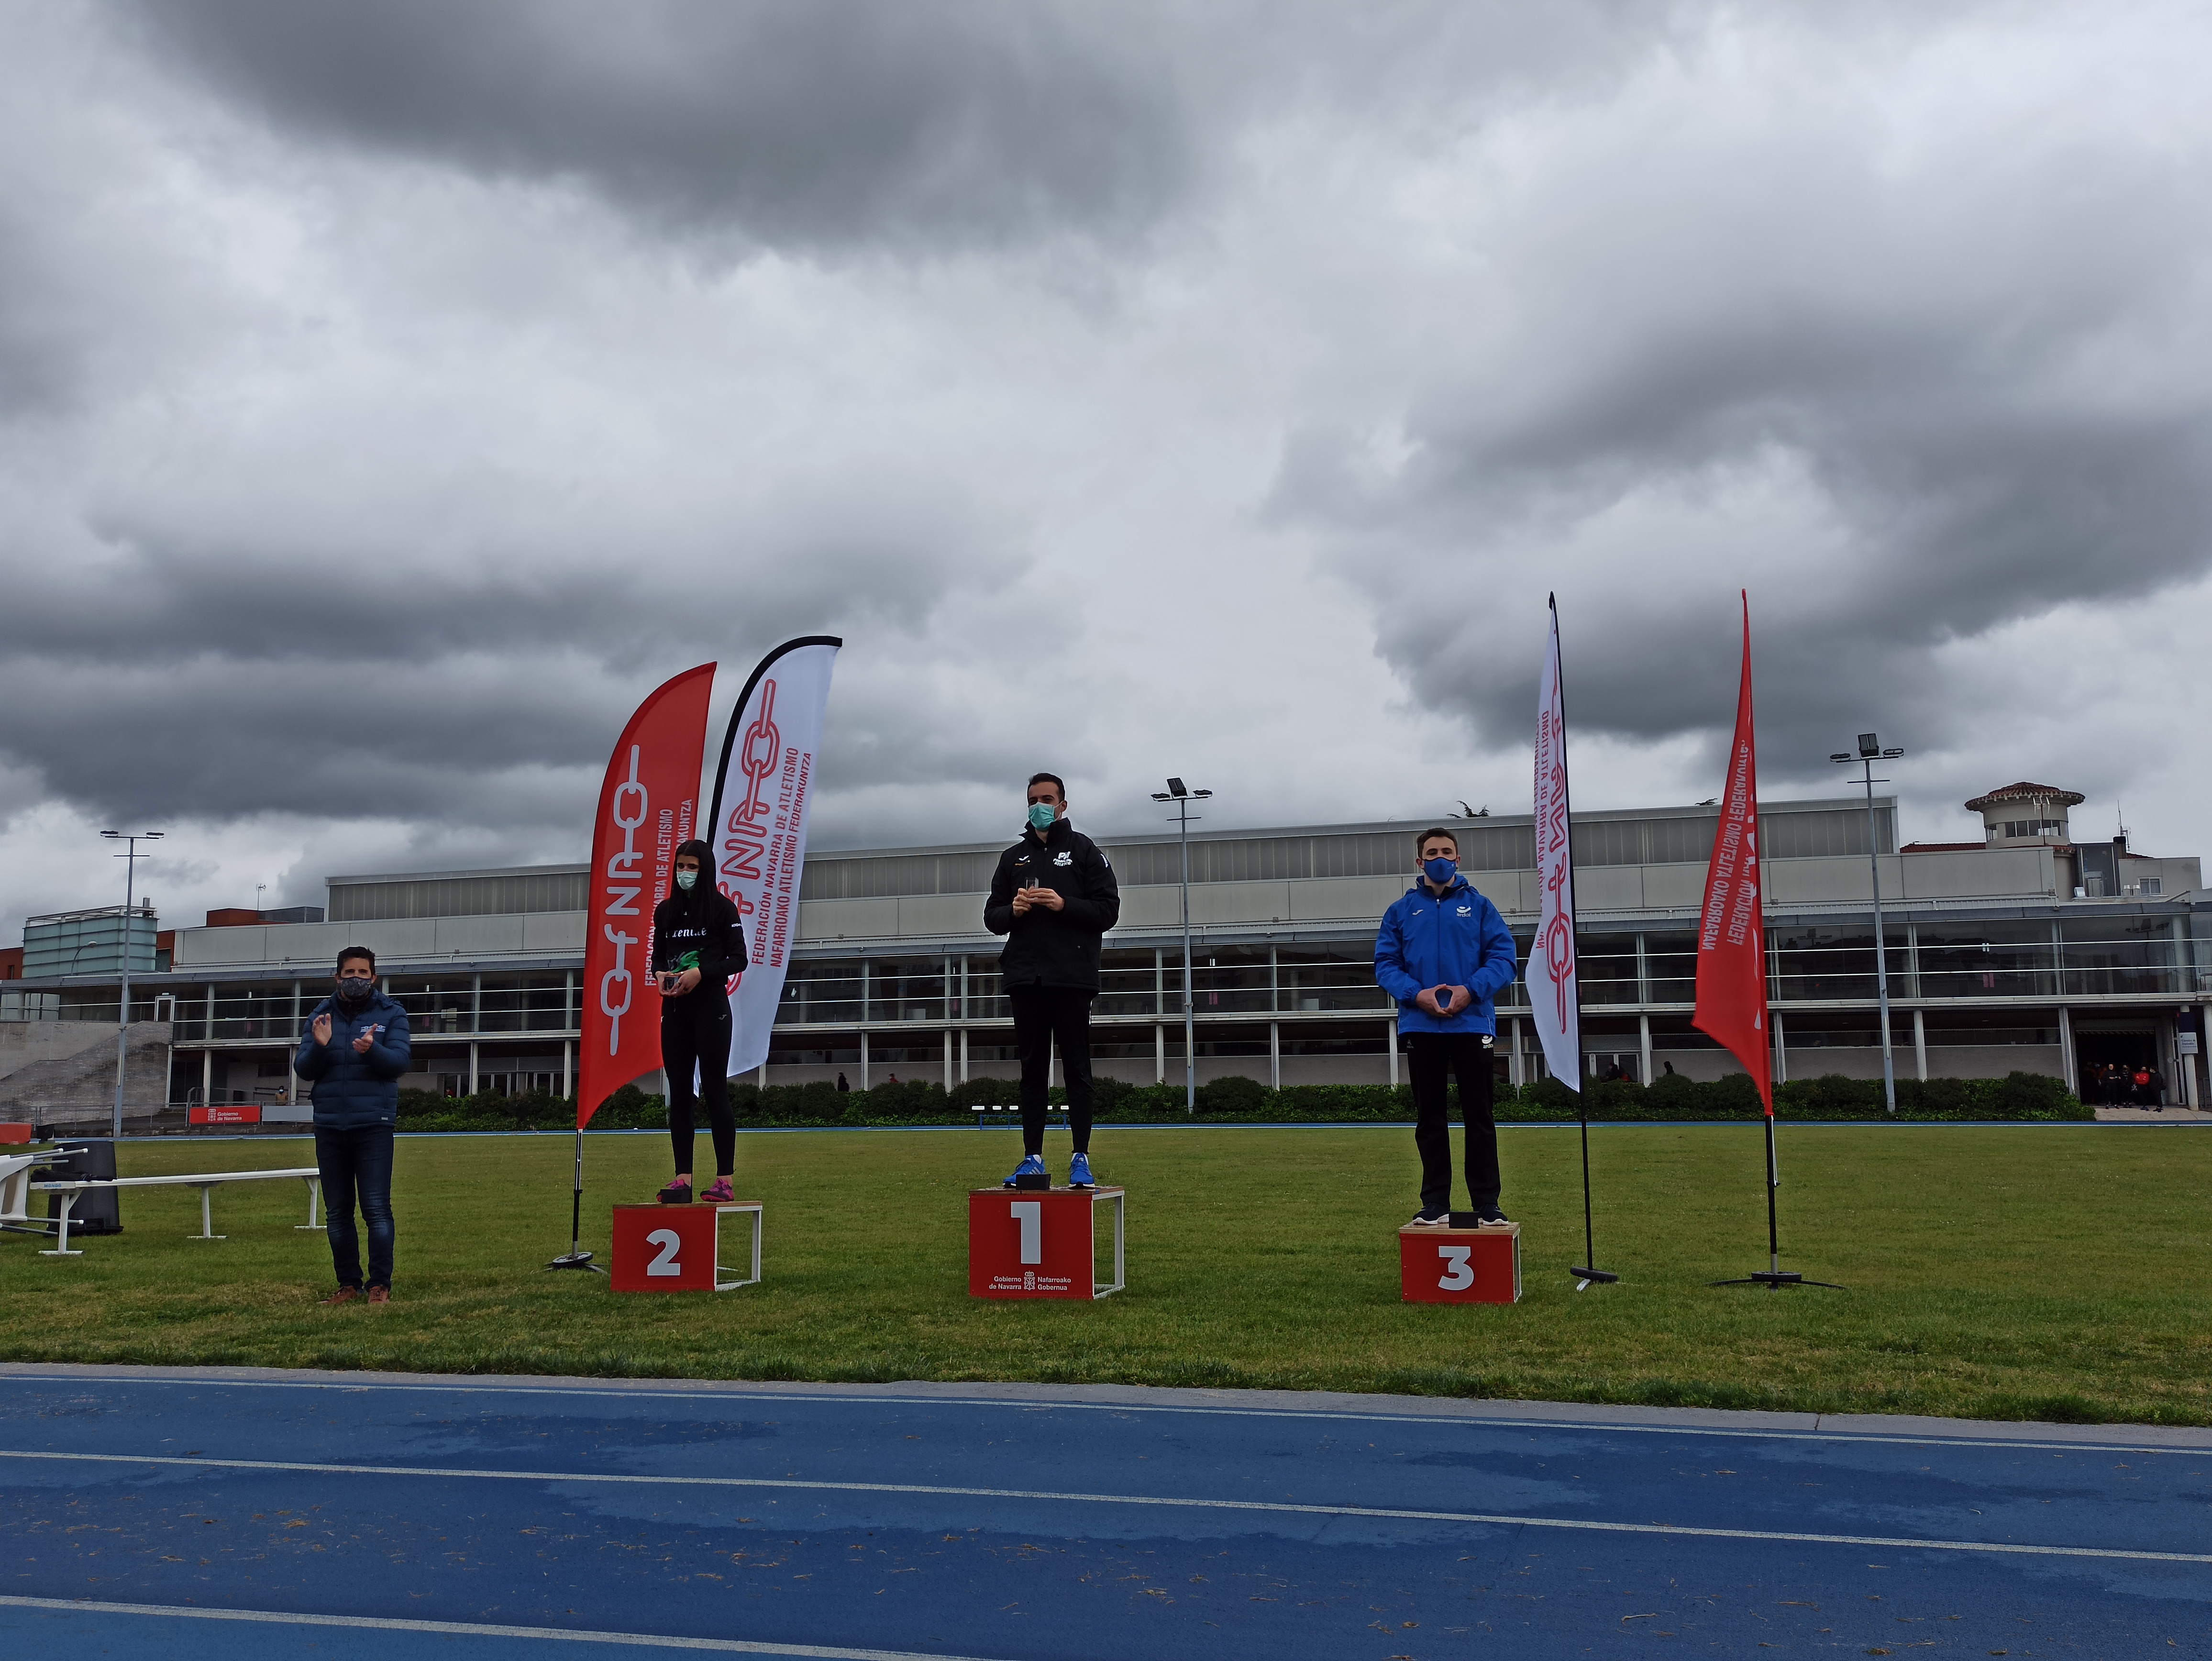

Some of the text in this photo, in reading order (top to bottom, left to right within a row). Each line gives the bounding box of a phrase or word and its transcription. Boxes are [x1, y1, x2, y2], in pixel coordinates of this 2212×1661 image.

[657, 809, 673, 862] ATLETISMO
[752, 747, 798, 965] FEDERACIÓN NAVARRA DE ATLETISMO
[770, 753, 811, 967] NAFARROAKO ATLETISMO FEDERAKUNTZA
[656, 864, 668, 876] DE
[646, 1229, 680, 1276] 2
[1011, 1202, 1041, 1264] 1
[1438, 1246, 1474, 1291] 3
